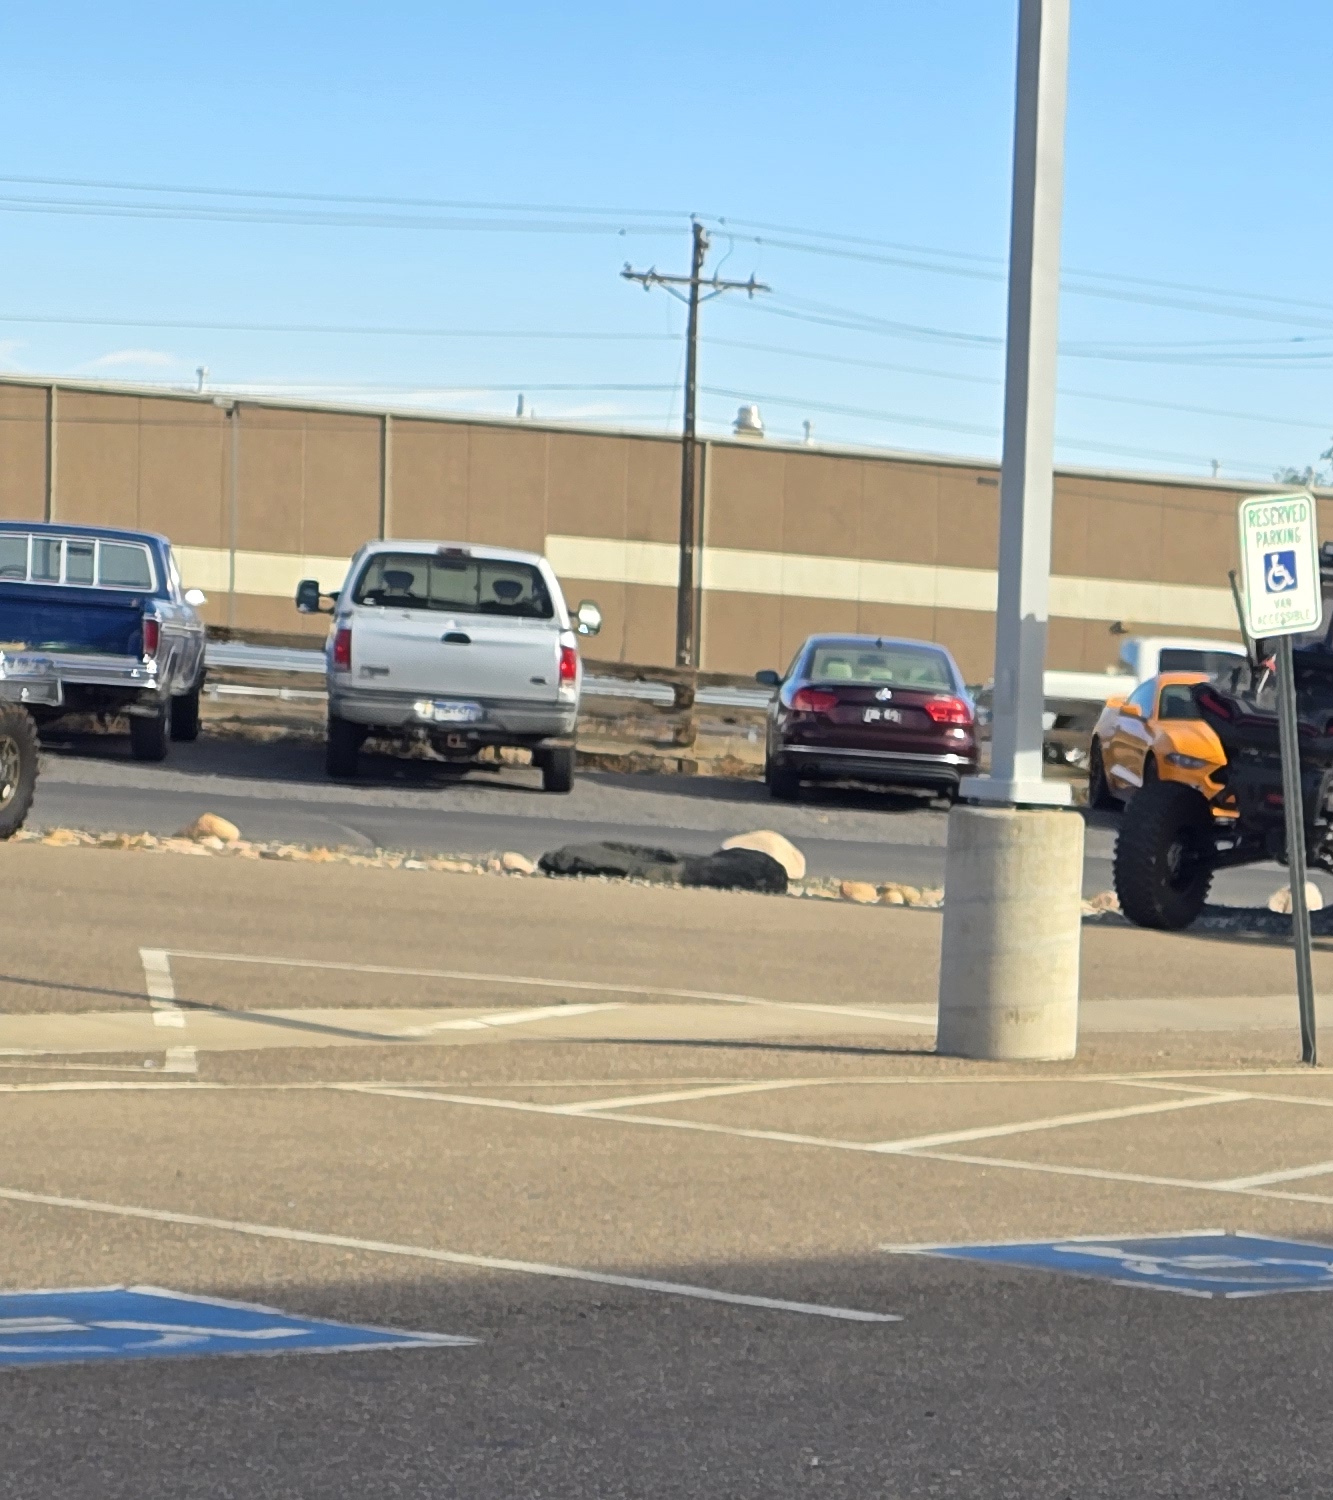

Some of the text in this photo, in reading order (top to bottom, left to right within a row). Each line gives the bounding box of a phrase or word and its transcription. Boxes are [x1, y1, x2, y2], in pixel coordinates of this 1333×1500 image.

[1248, 503, 1307, 528] RESERVED
[1256, 527, 1302, 548] PARKING
[1274, 598, 1292, 608] VAN
